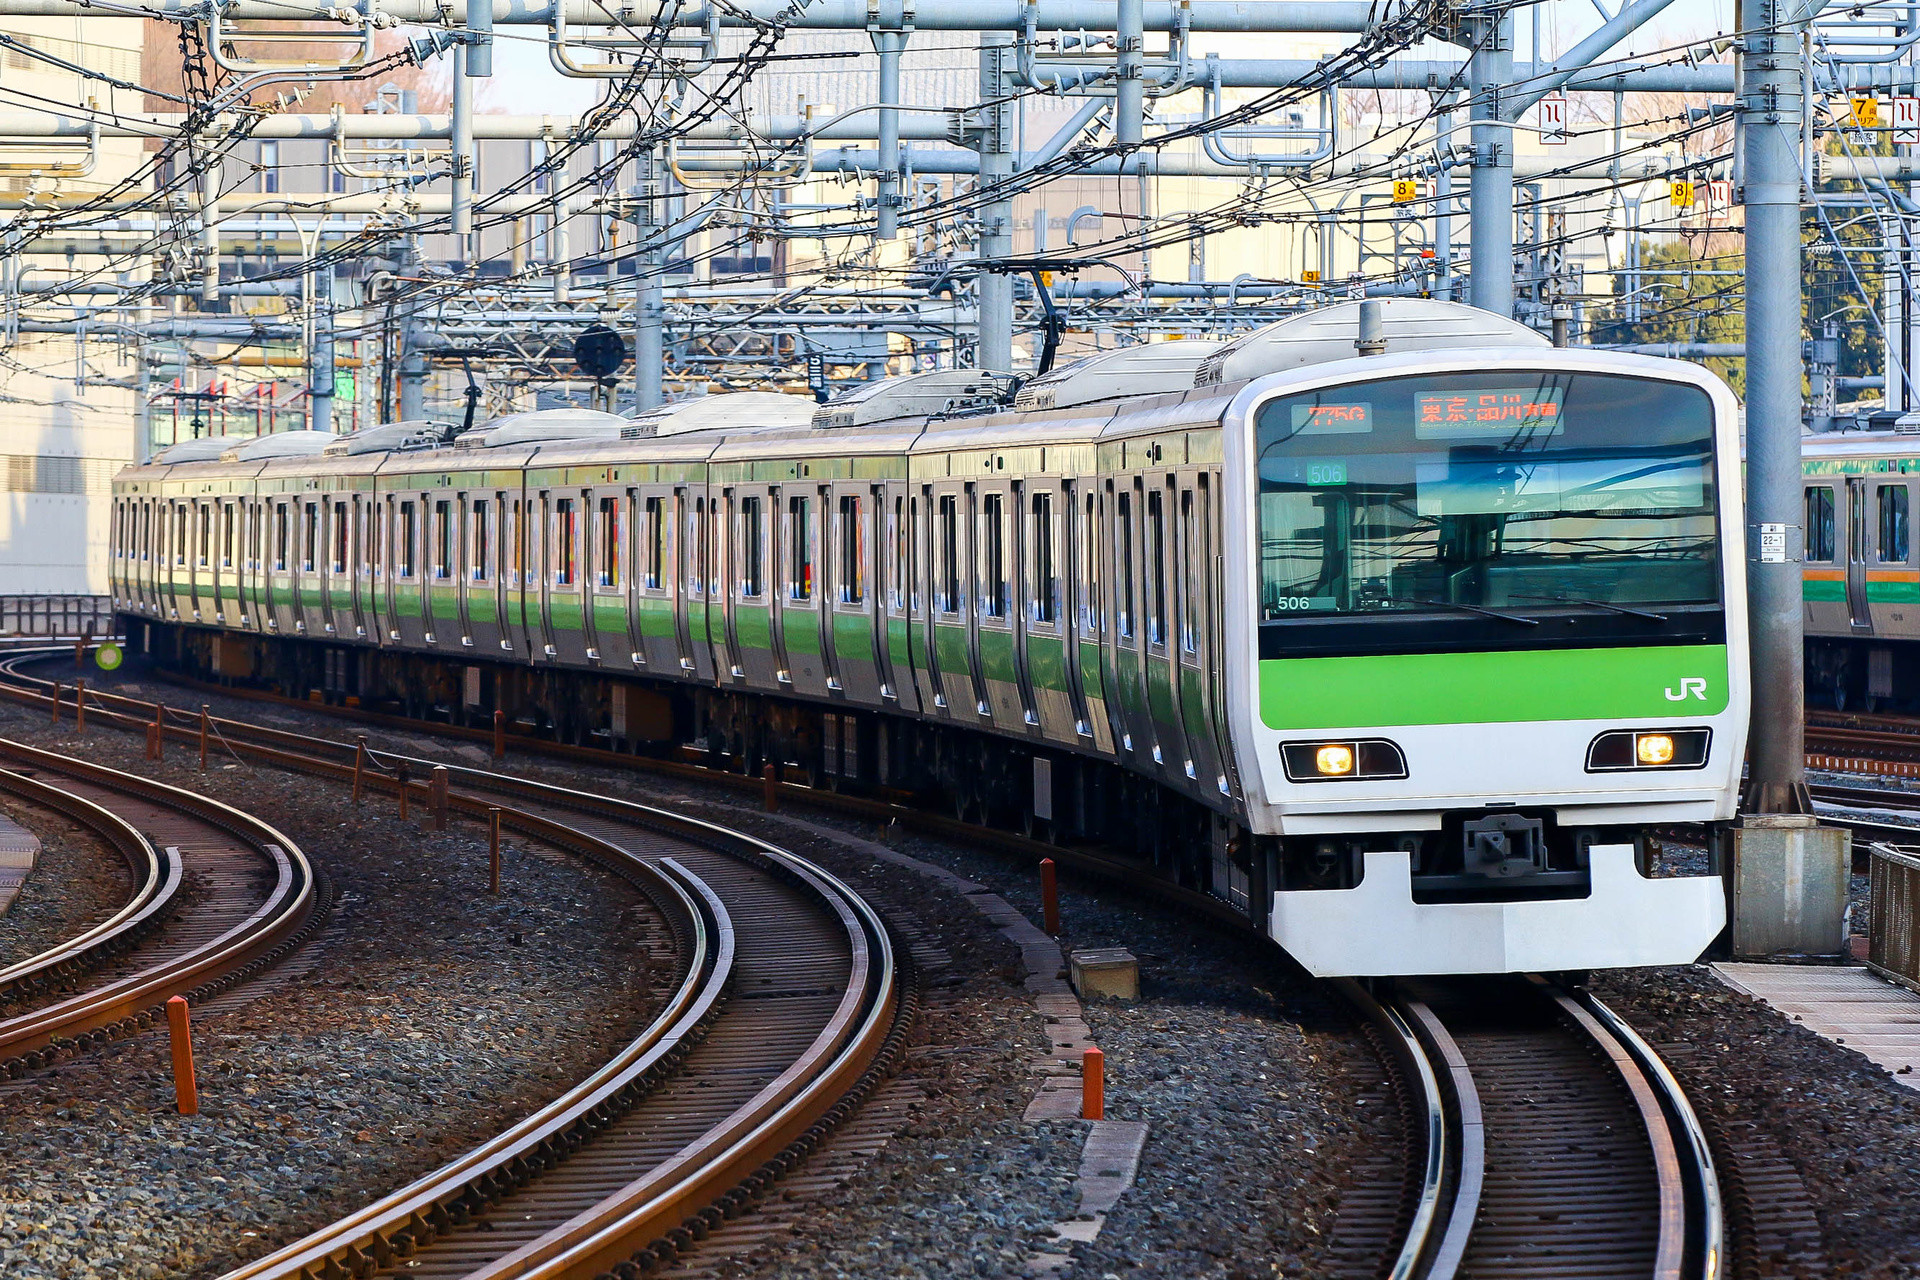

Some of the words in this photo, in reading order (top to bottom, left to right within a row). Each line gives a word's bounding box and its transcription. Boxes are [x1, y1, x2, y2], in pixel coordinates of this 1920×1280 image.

[1856, 100, 1866, 114] 7
[1398, 183, 1406, 194] 8
[1675, 184, 1684, 197] 8
[1311, 465, 1342, 484] 506
[1763, 535, 1783, 545] 22-1
[1278, 596, 1310, 610] 506
[1664, 677, 1707, 701] JR
